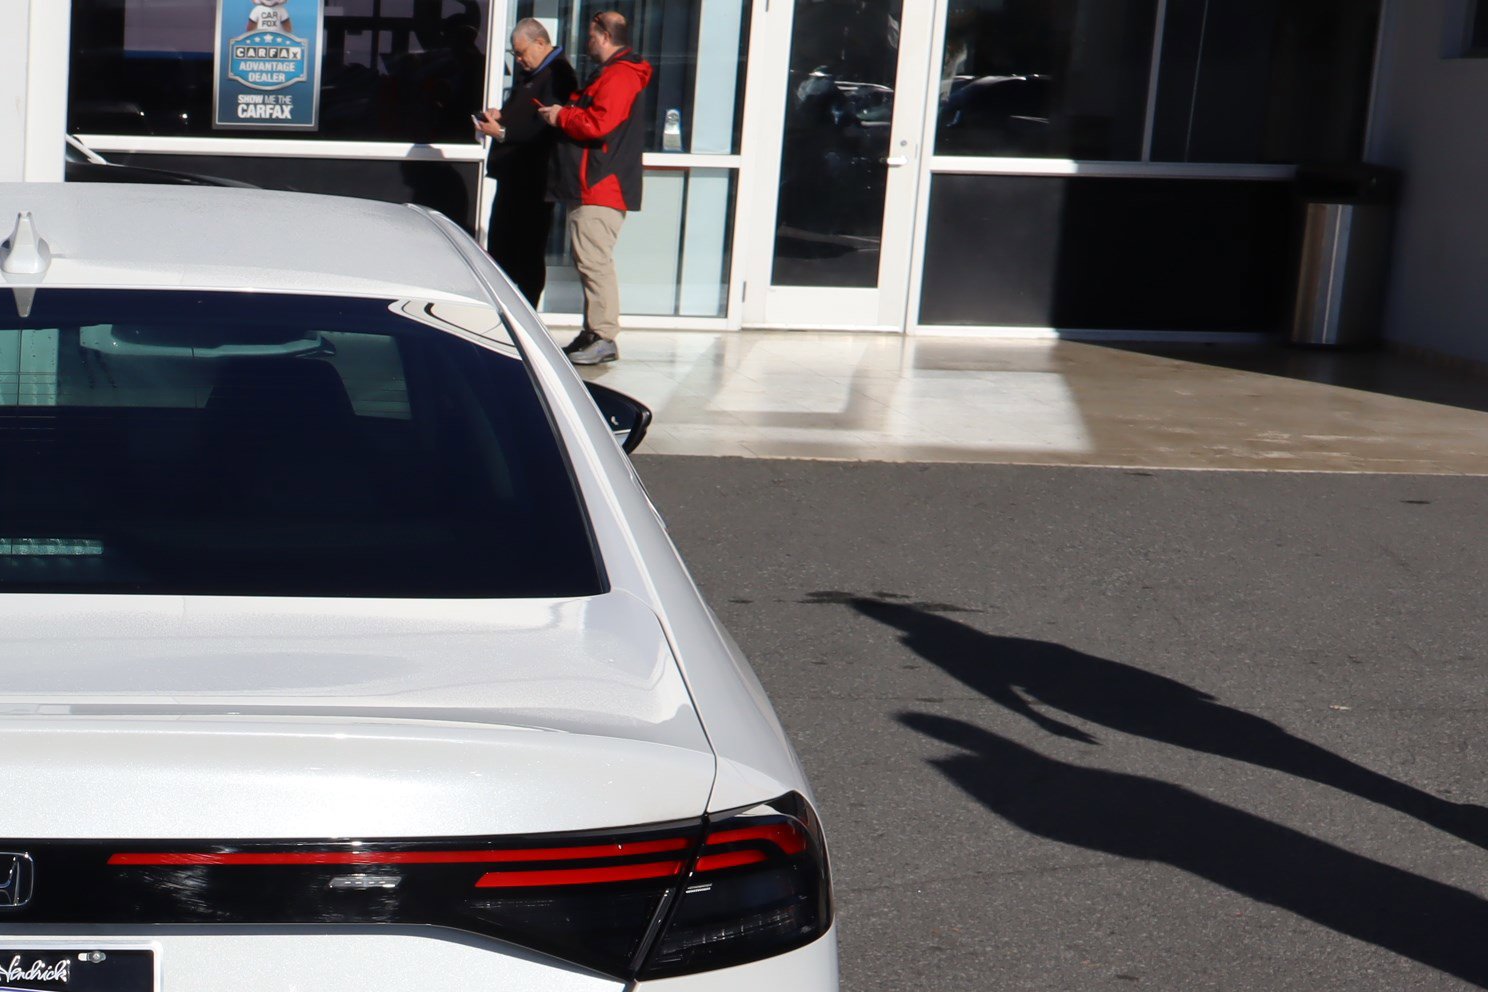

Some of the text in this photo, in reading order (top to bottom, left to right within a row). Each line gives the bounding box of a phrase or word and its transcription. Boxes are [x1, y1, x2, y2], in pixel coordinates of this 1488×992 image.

[260, 11, 279, 19] CAR
[235, 47, 300, 59] CARFAX
[239, 61, 296, 71] ADVANTAGE
[248, 72, 286, 82] DEALER
[238, 94, 292, 104] SHOW ME THE
[237, 104, 293, 119] CARFAX
